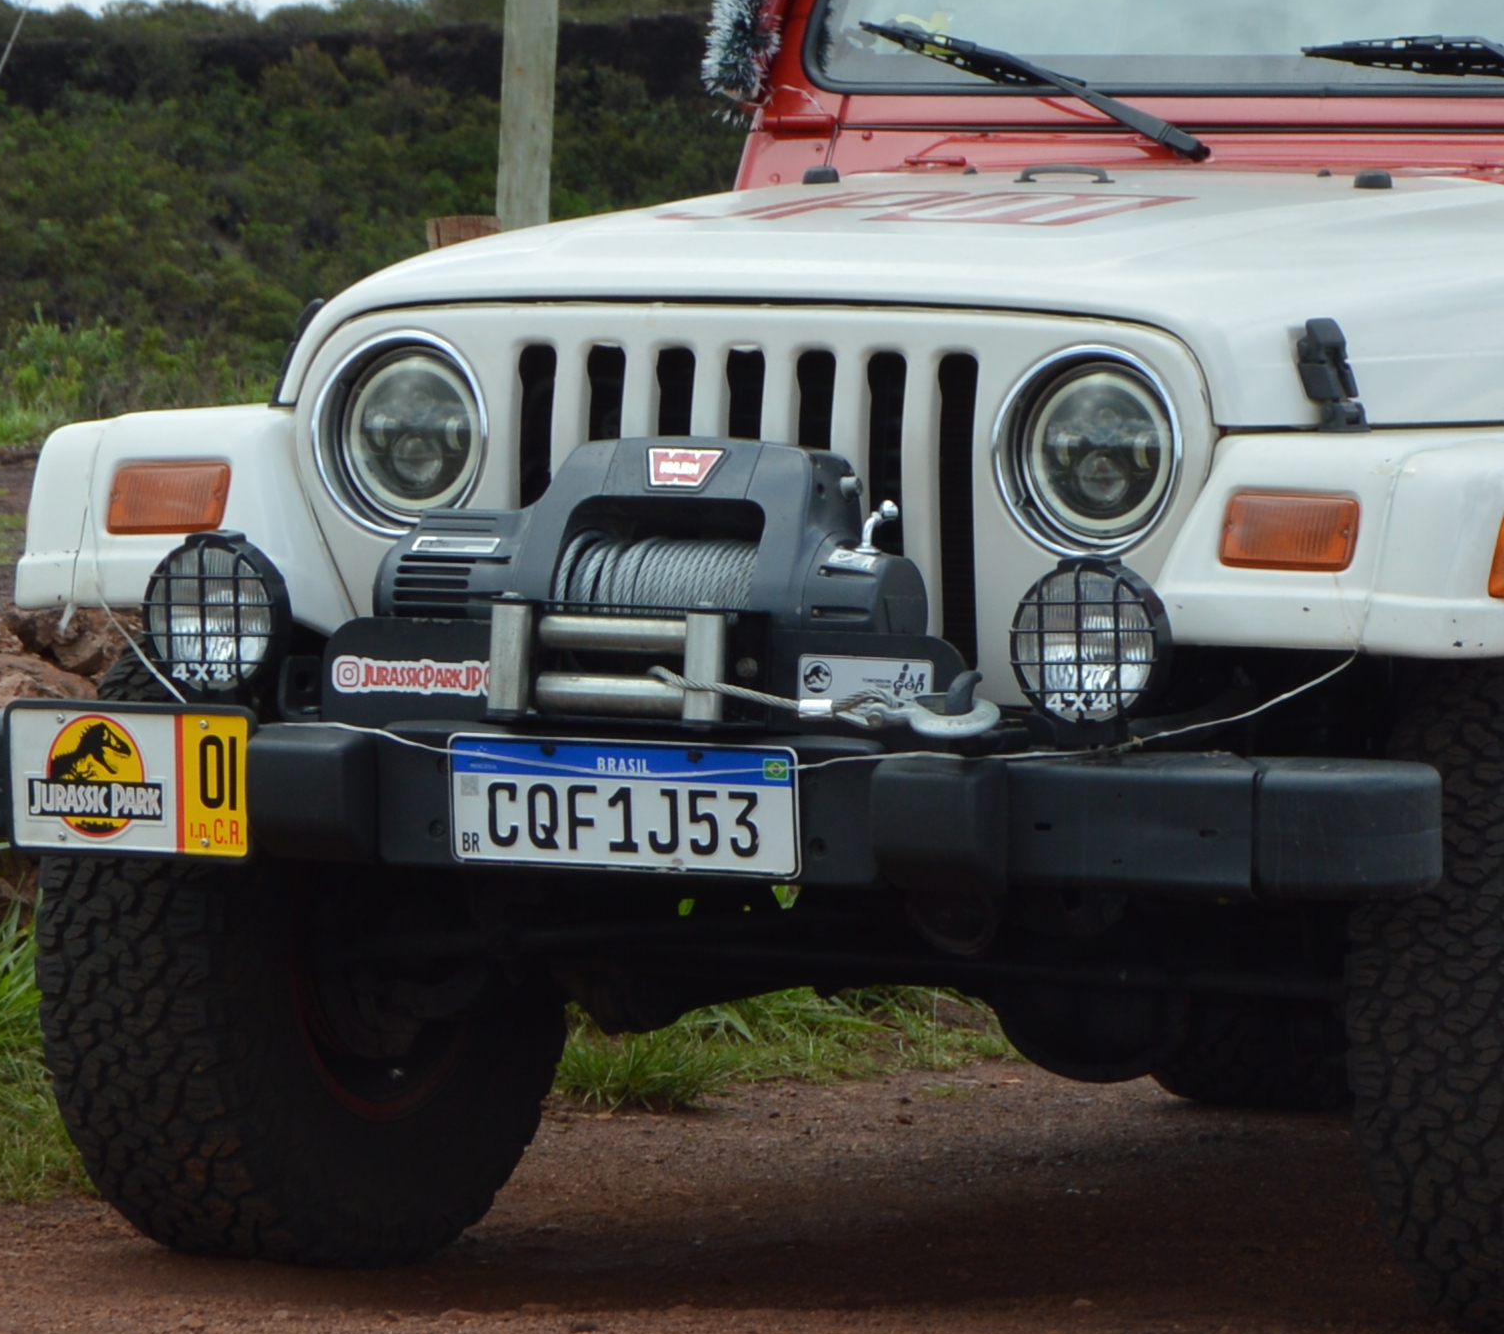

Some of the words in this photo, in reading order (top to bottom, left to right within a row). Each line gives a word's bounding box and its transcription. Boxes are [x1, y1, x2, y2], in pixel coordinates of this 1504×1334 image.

[199, 734, 238, 811] 01
[597, 756, 650, 774] BRASIL
[31, 780, 109, 815] JURASSIC
[111, 783, 162, 817] PARK
[487, 781, 760, 858] CQF1J53
[462, 832, 481, 853] BR
